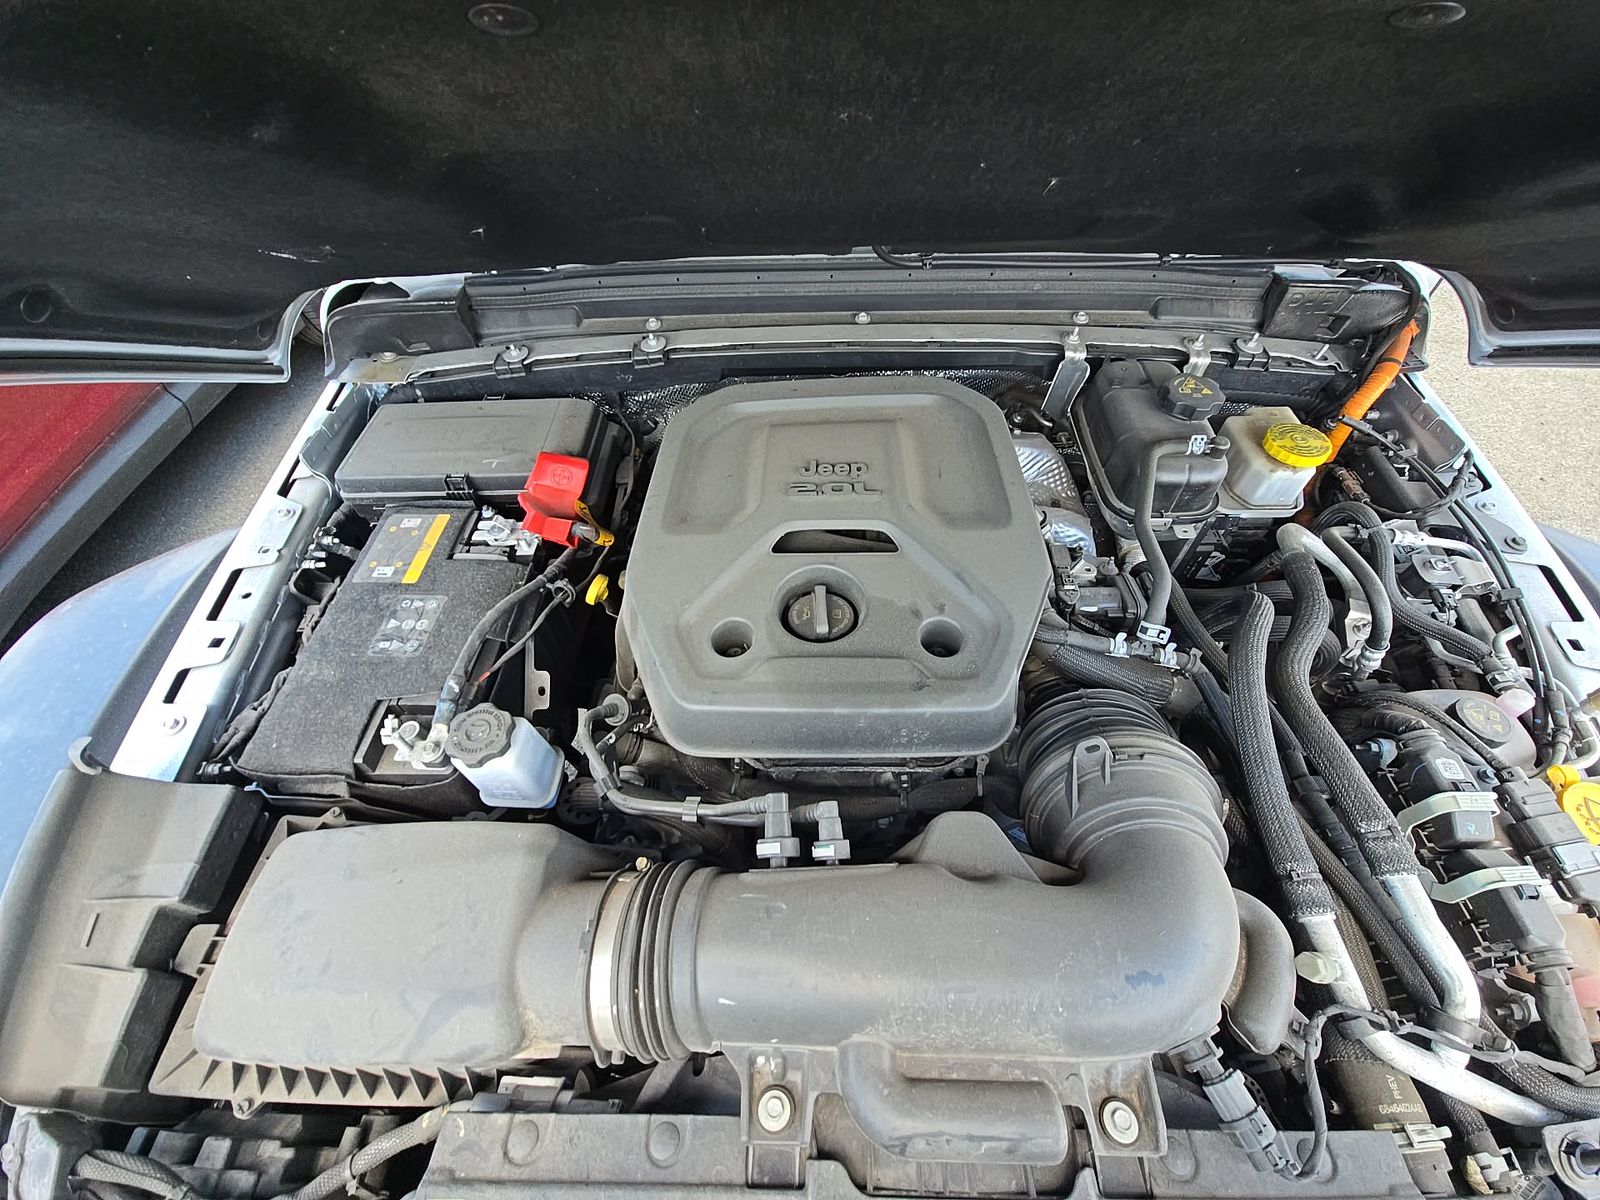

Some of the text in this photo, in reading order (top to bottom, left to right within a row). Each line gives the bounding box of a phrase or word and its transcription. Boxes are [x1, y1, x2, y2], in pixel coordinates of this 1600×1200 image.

[798, 459, 869, 479] Jeep
[788, 481, 883, 496] 2.0L
[1385, 1074, 1403, 1099] PHEV
